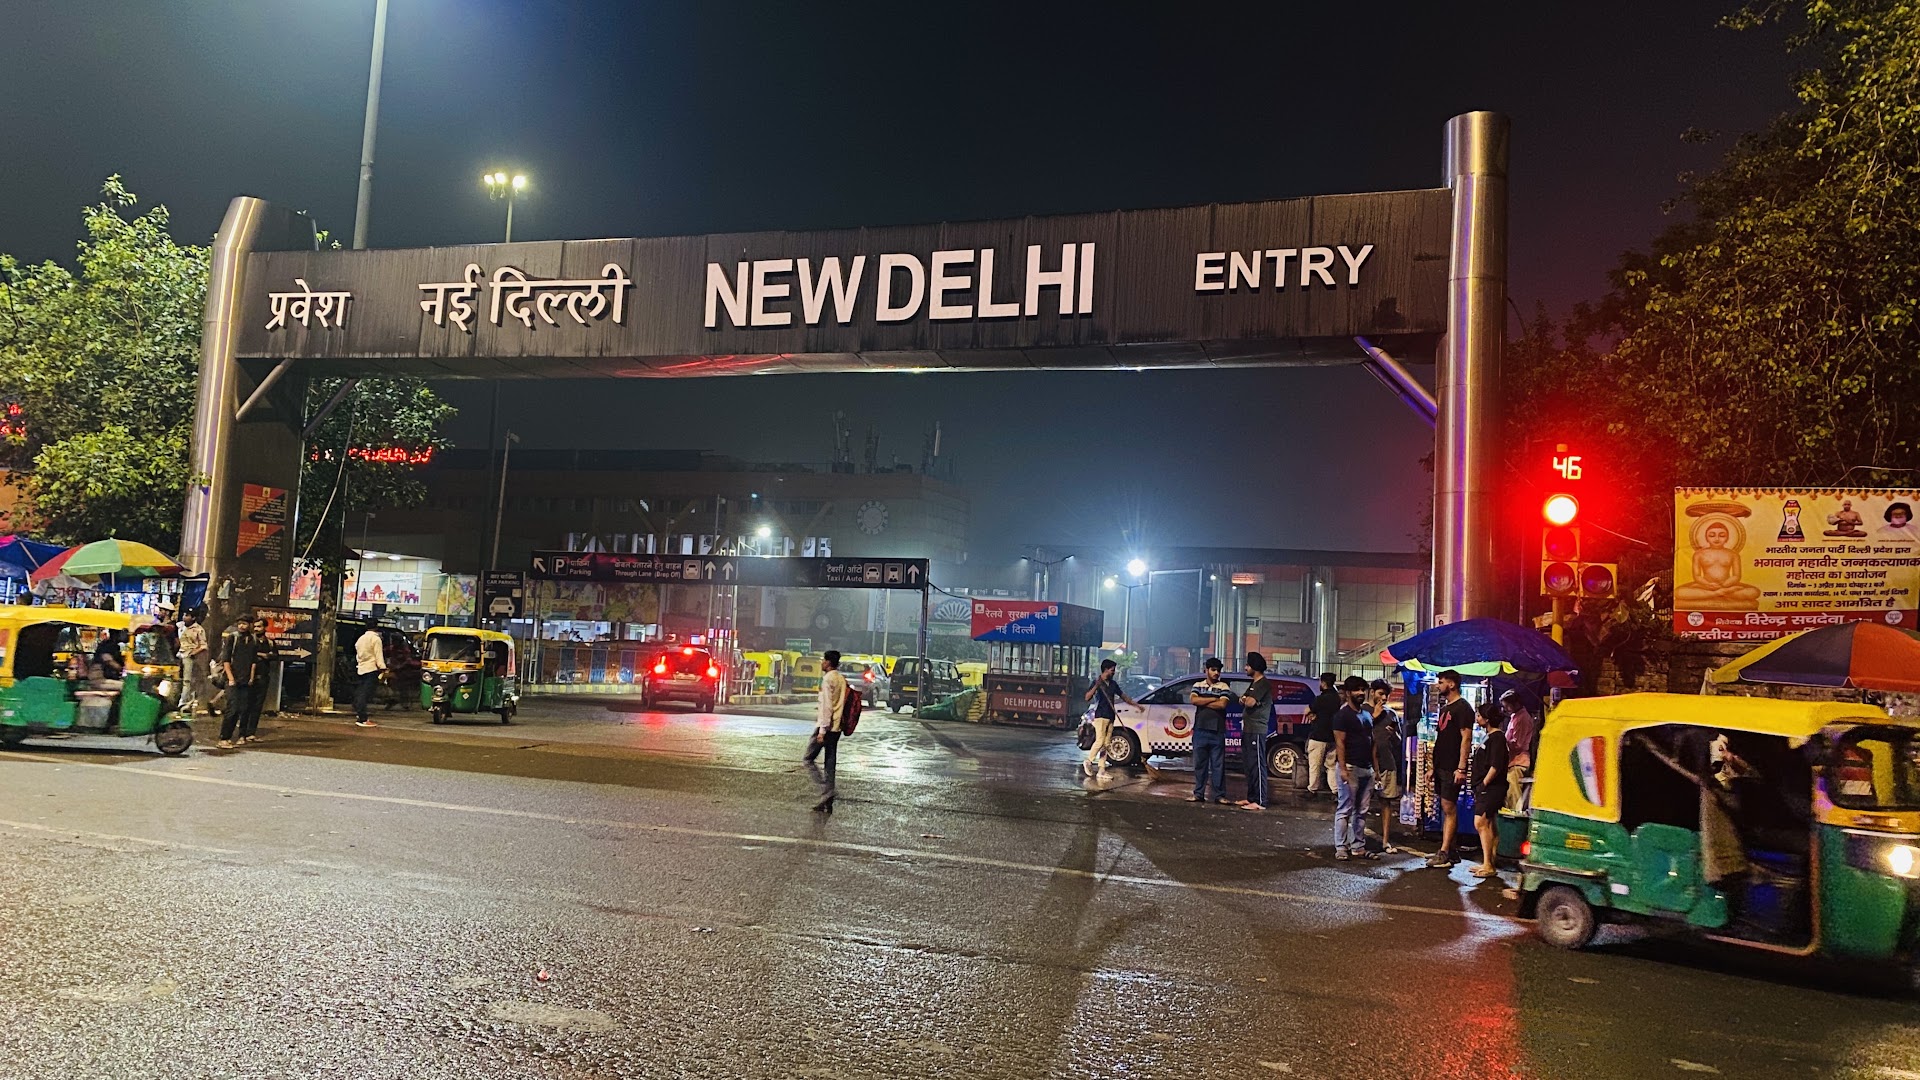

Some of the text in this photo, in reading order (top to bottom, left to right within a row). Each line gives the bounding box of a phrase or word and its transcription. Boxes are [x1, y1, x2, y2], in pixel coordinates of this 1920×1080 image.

[1195, 244, 1375, 291] ENTRY
[705, 242, 1095, 328] NEW DELHI
[418, 263, 632, 332] नई दिल्ली
[265, 279, 351, 330] प्रवेश
[1552, 456, 1582, 480] 46
[1765, 545, 1797, 554] भारतीय
[1828, 545, 1846, 554] पार्टी
[1848, 545, 1871, 554] दिल्ली
[1873, 546, 1893, 554] प्रदेश
[1753, 555, 1920, 568] भगवान महावीर जन्मकल्याणक
[569, 568, 592, 576] Parking
[615, 570, 637, 578] Through
[1786, 568, 1887, 580] महोत्सव का आयोजन
[1774, 600, 1799, 608] आप
[1801, 600, 1832, 608] सादर
[985, 608, 1048, 621] रेलवे सुरक्षा बल
[1745, 613, 1788, 627] विरेन्द्र
[1791, 612, 1845, 625] सचदेवा
[995, 623, 1036, 634] नई दिल्ली
[1736, 630, 1781, 639] जनता
[1004, 697, 1055, 709] DELHI POLICE
